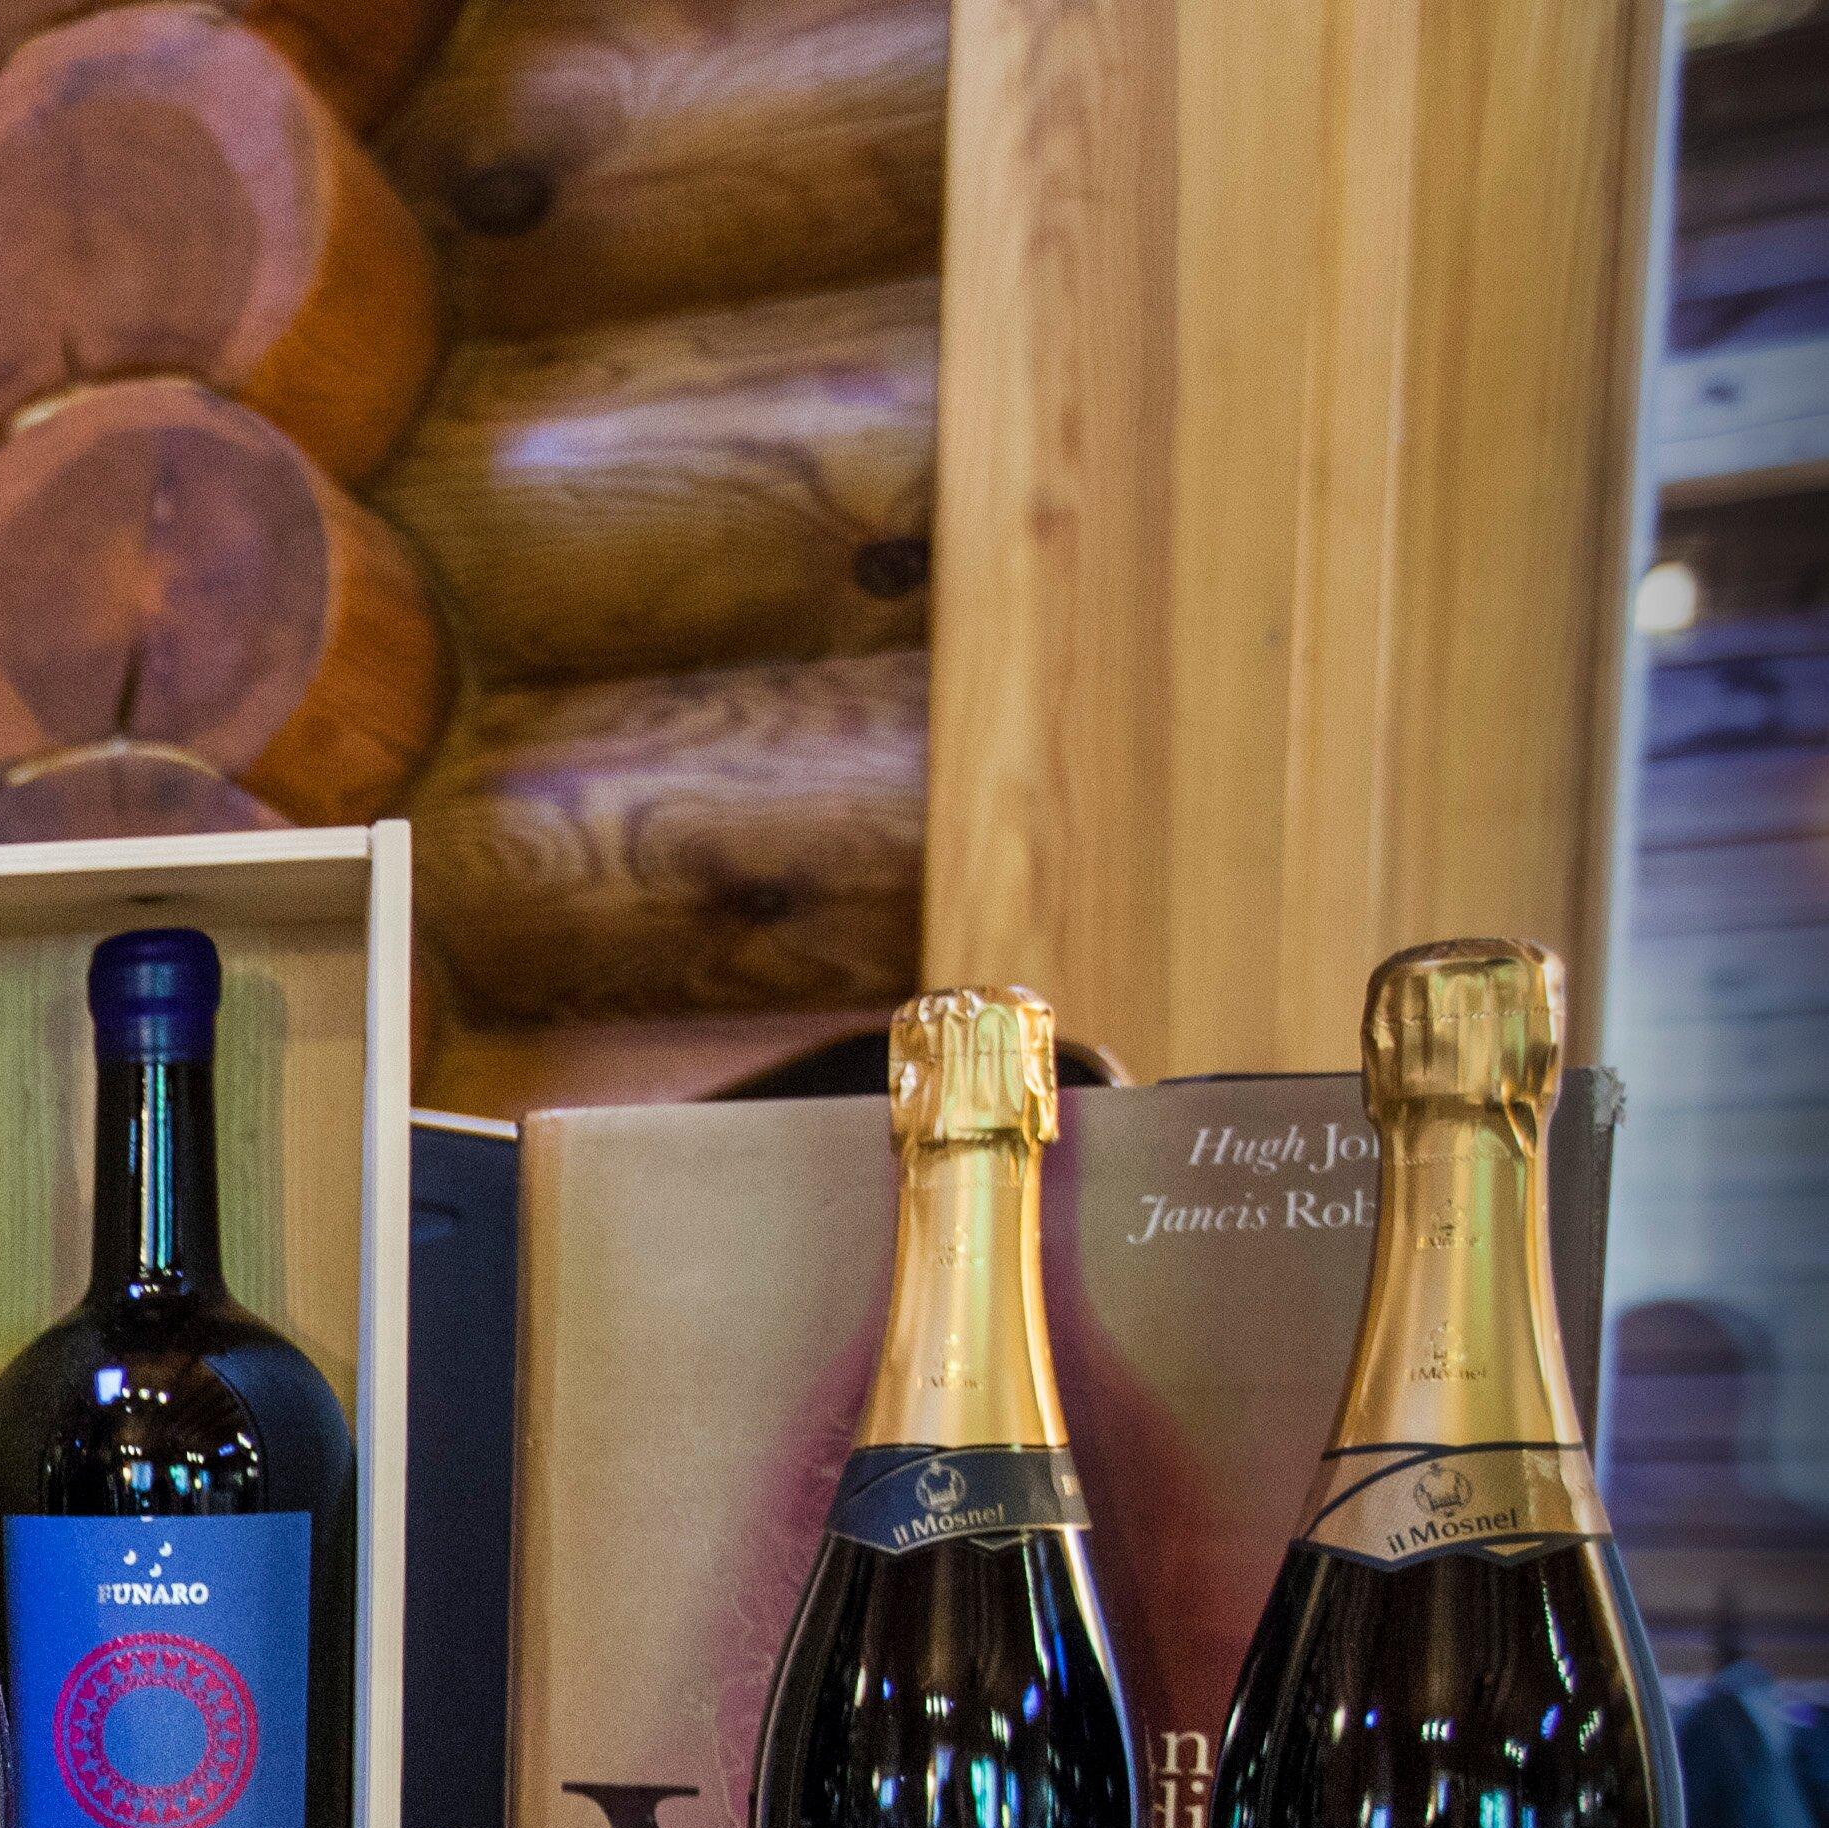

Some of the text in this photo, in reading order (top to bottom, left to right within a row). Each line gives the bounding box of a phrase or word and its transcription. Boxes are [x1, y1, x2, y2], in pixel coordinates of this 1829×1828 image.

[1189, 1124, 1305, 1175] Hugh
[1127, 1192, 1271, 1245] Jancis
[911, 1503, 1005, 1539] Mosnel
[1409, 1507, 1519, 1546] Mosnel
[97, 1583, 209, 1606] FUNARO
